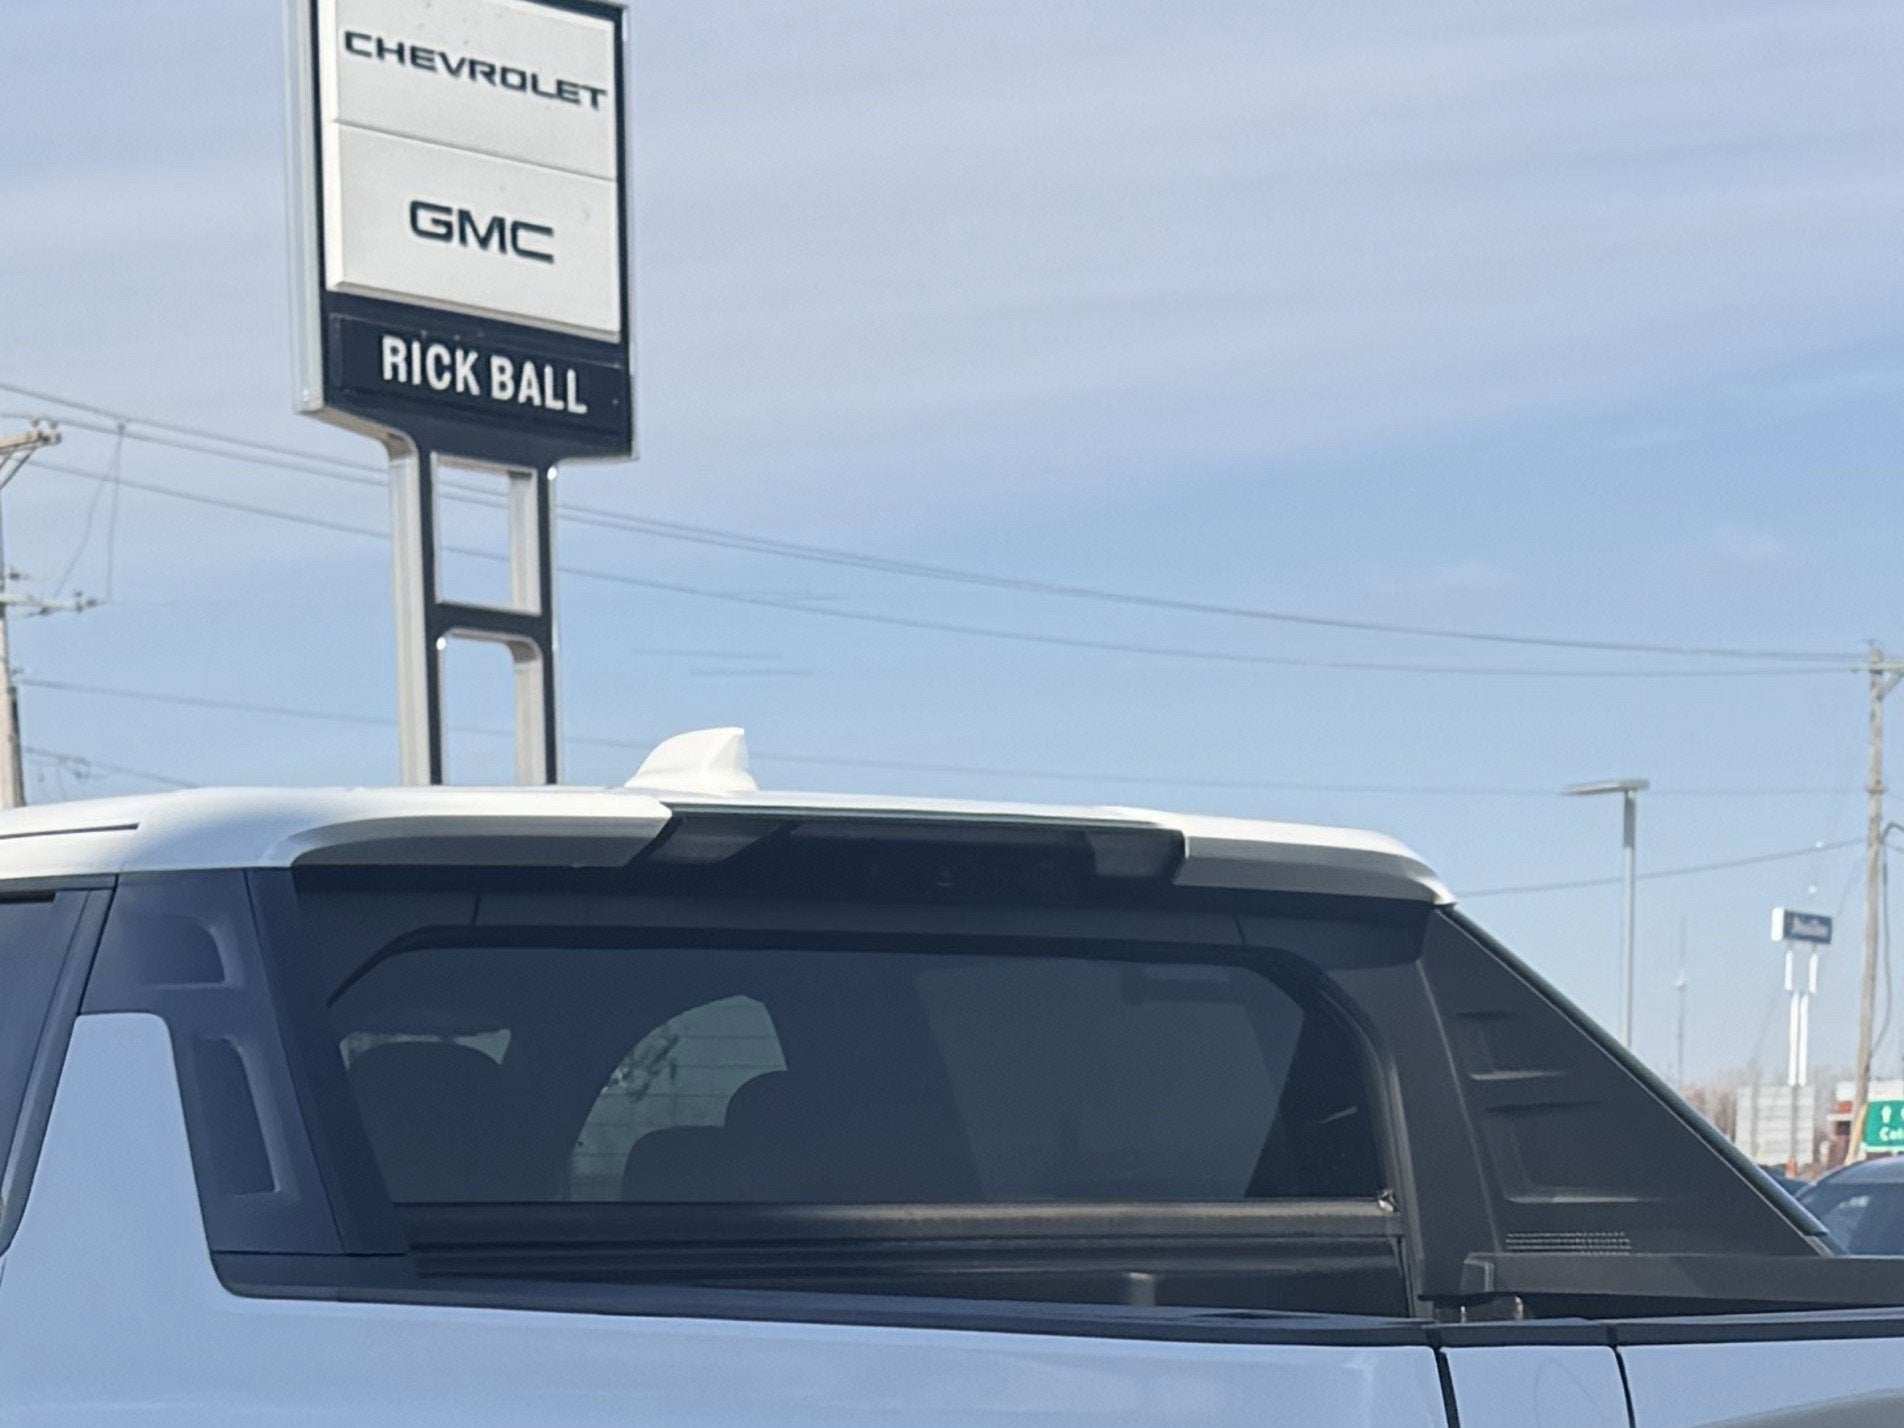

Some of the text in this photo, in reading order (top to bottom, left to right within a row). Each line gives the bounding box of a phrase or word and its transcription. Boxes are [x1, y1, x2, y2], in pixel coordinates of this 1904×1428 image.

[343, 30, 608, 111] CHEVROLET
[409, 199, 555, 264] GMC
[381, 335, 588, 414] RICK BALL
